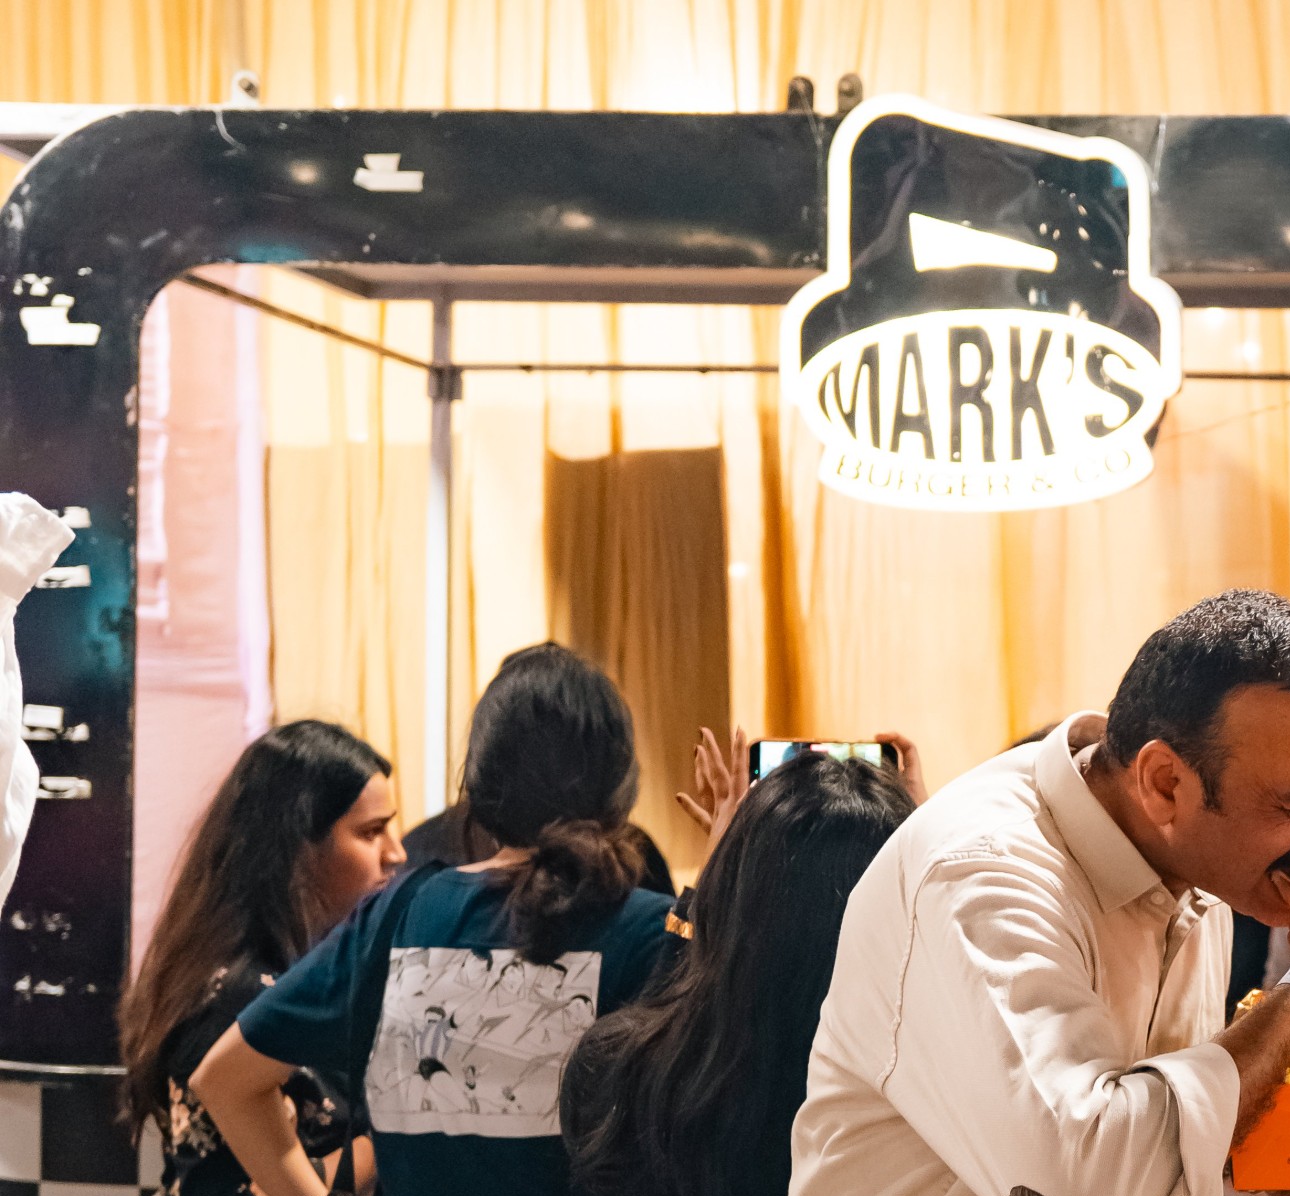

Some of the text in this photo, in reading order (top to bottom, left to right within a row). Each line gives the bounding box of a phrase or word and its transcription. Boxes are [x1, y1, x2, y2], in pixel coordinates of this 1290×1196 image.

[817, 326, 1144, 462] MARK'S
[835, 447, 1131, 497] BURGER & CO
